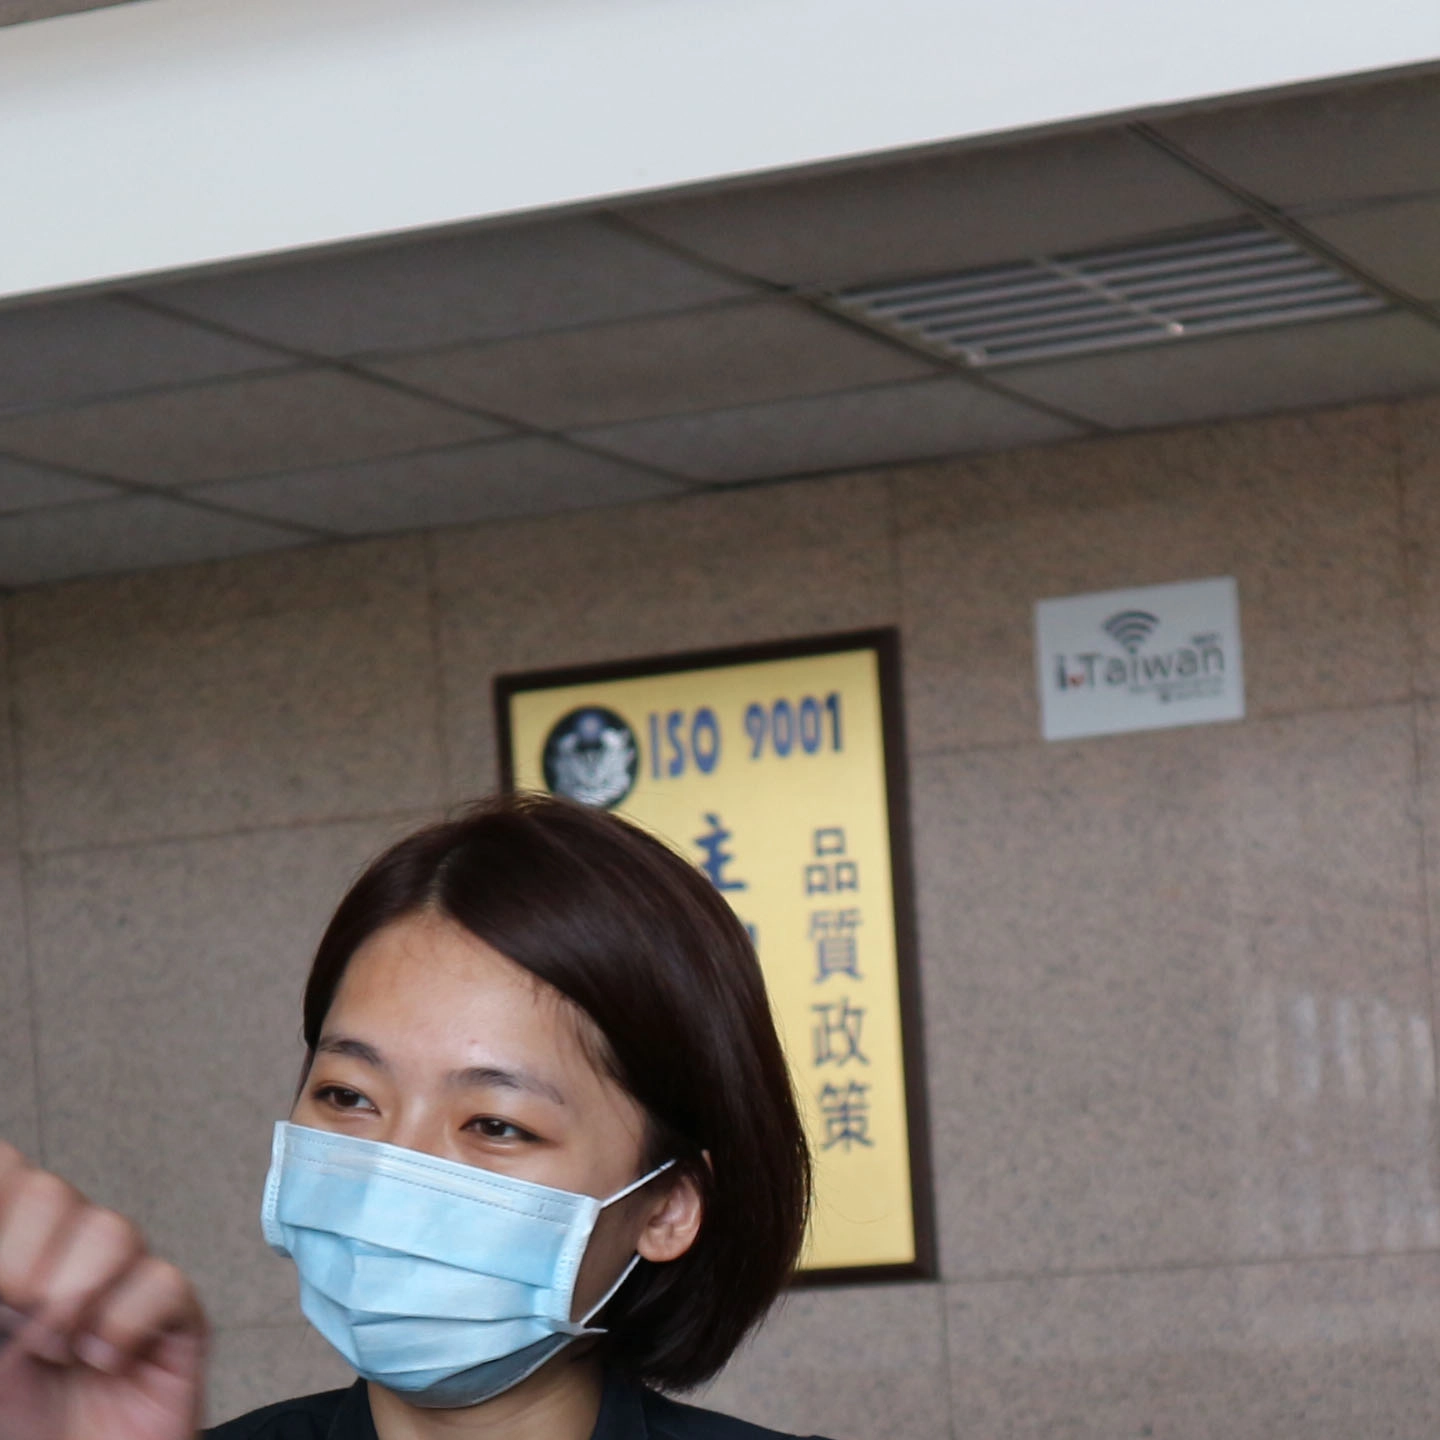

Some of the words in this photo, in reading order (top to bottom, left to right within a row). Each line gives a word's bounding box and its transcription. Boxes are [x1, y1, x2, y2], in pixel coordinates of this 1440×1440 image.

[647, 704, 719, 779] ISO
[744, 693, 843, 758] 9001
[803, 827, 875, 1152] 品質政策
